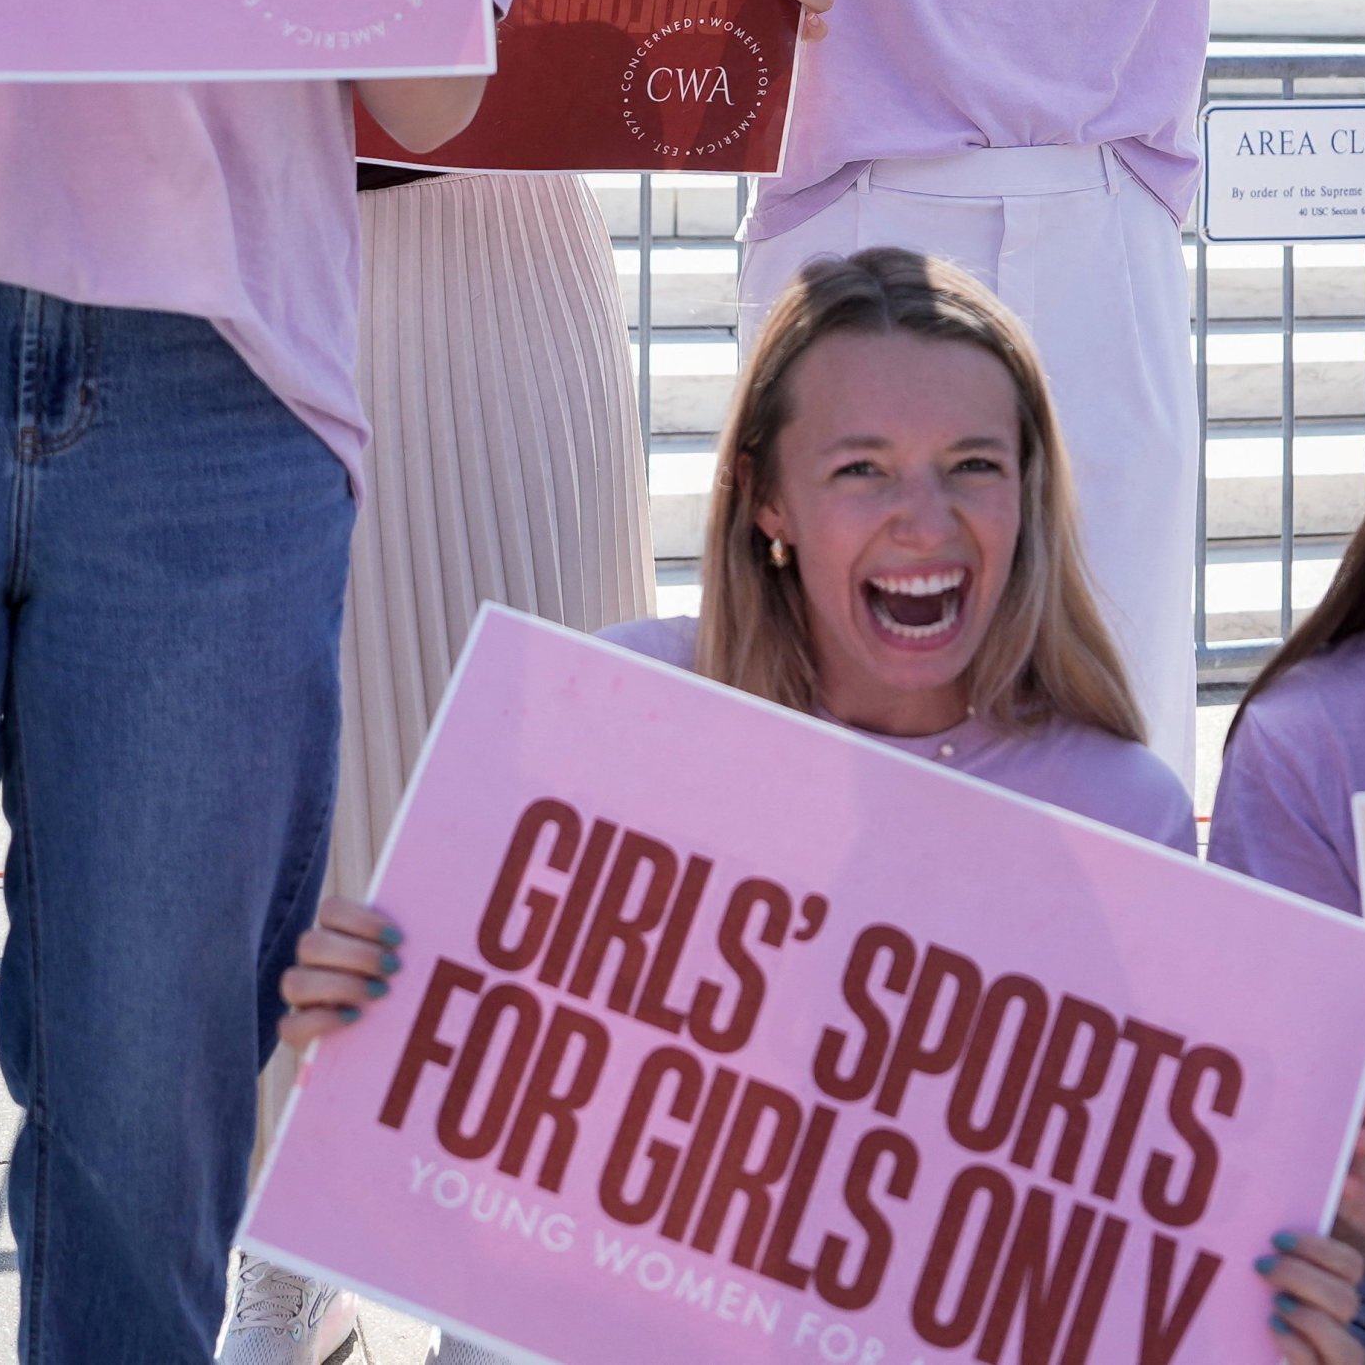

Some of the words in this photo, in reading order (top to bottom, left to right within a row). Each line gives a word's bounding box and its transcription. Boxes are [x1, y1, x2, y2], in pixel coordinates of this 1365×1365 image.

[284, 19, 386, 50] AMERICA
[710, 17, 760, 54] WOMEN
[621, 18, 692, 92] CONCERNED
[647, 66, 735, 106] CWA
[757, 68, 768, 96] FOR
[623, 110, 646, 140] 1979
[696, 110, 757, 155] AMERICA
[1236, 130, 1316, 156] AREA
[1232, 186, 1244, 200] By
[1250, 187, 1278, 198] order
[1283, 185, 1295, 197] of
[1300, 186, 1316, 197] the
[1321, 185, 1362, 199] Supreme
[1311, 207, 1328, 216] USC
[1331, 207, 1358, 216] Section
[813, 921, 1244, 1228] SPORTS
[377, 956, 612, 1196] FOR
[596, 1045, 921, 1313] GIRLS
[407, 1155, 576, 1255] YOUNG
[592, 1229, 784, 1338] WOMEN
